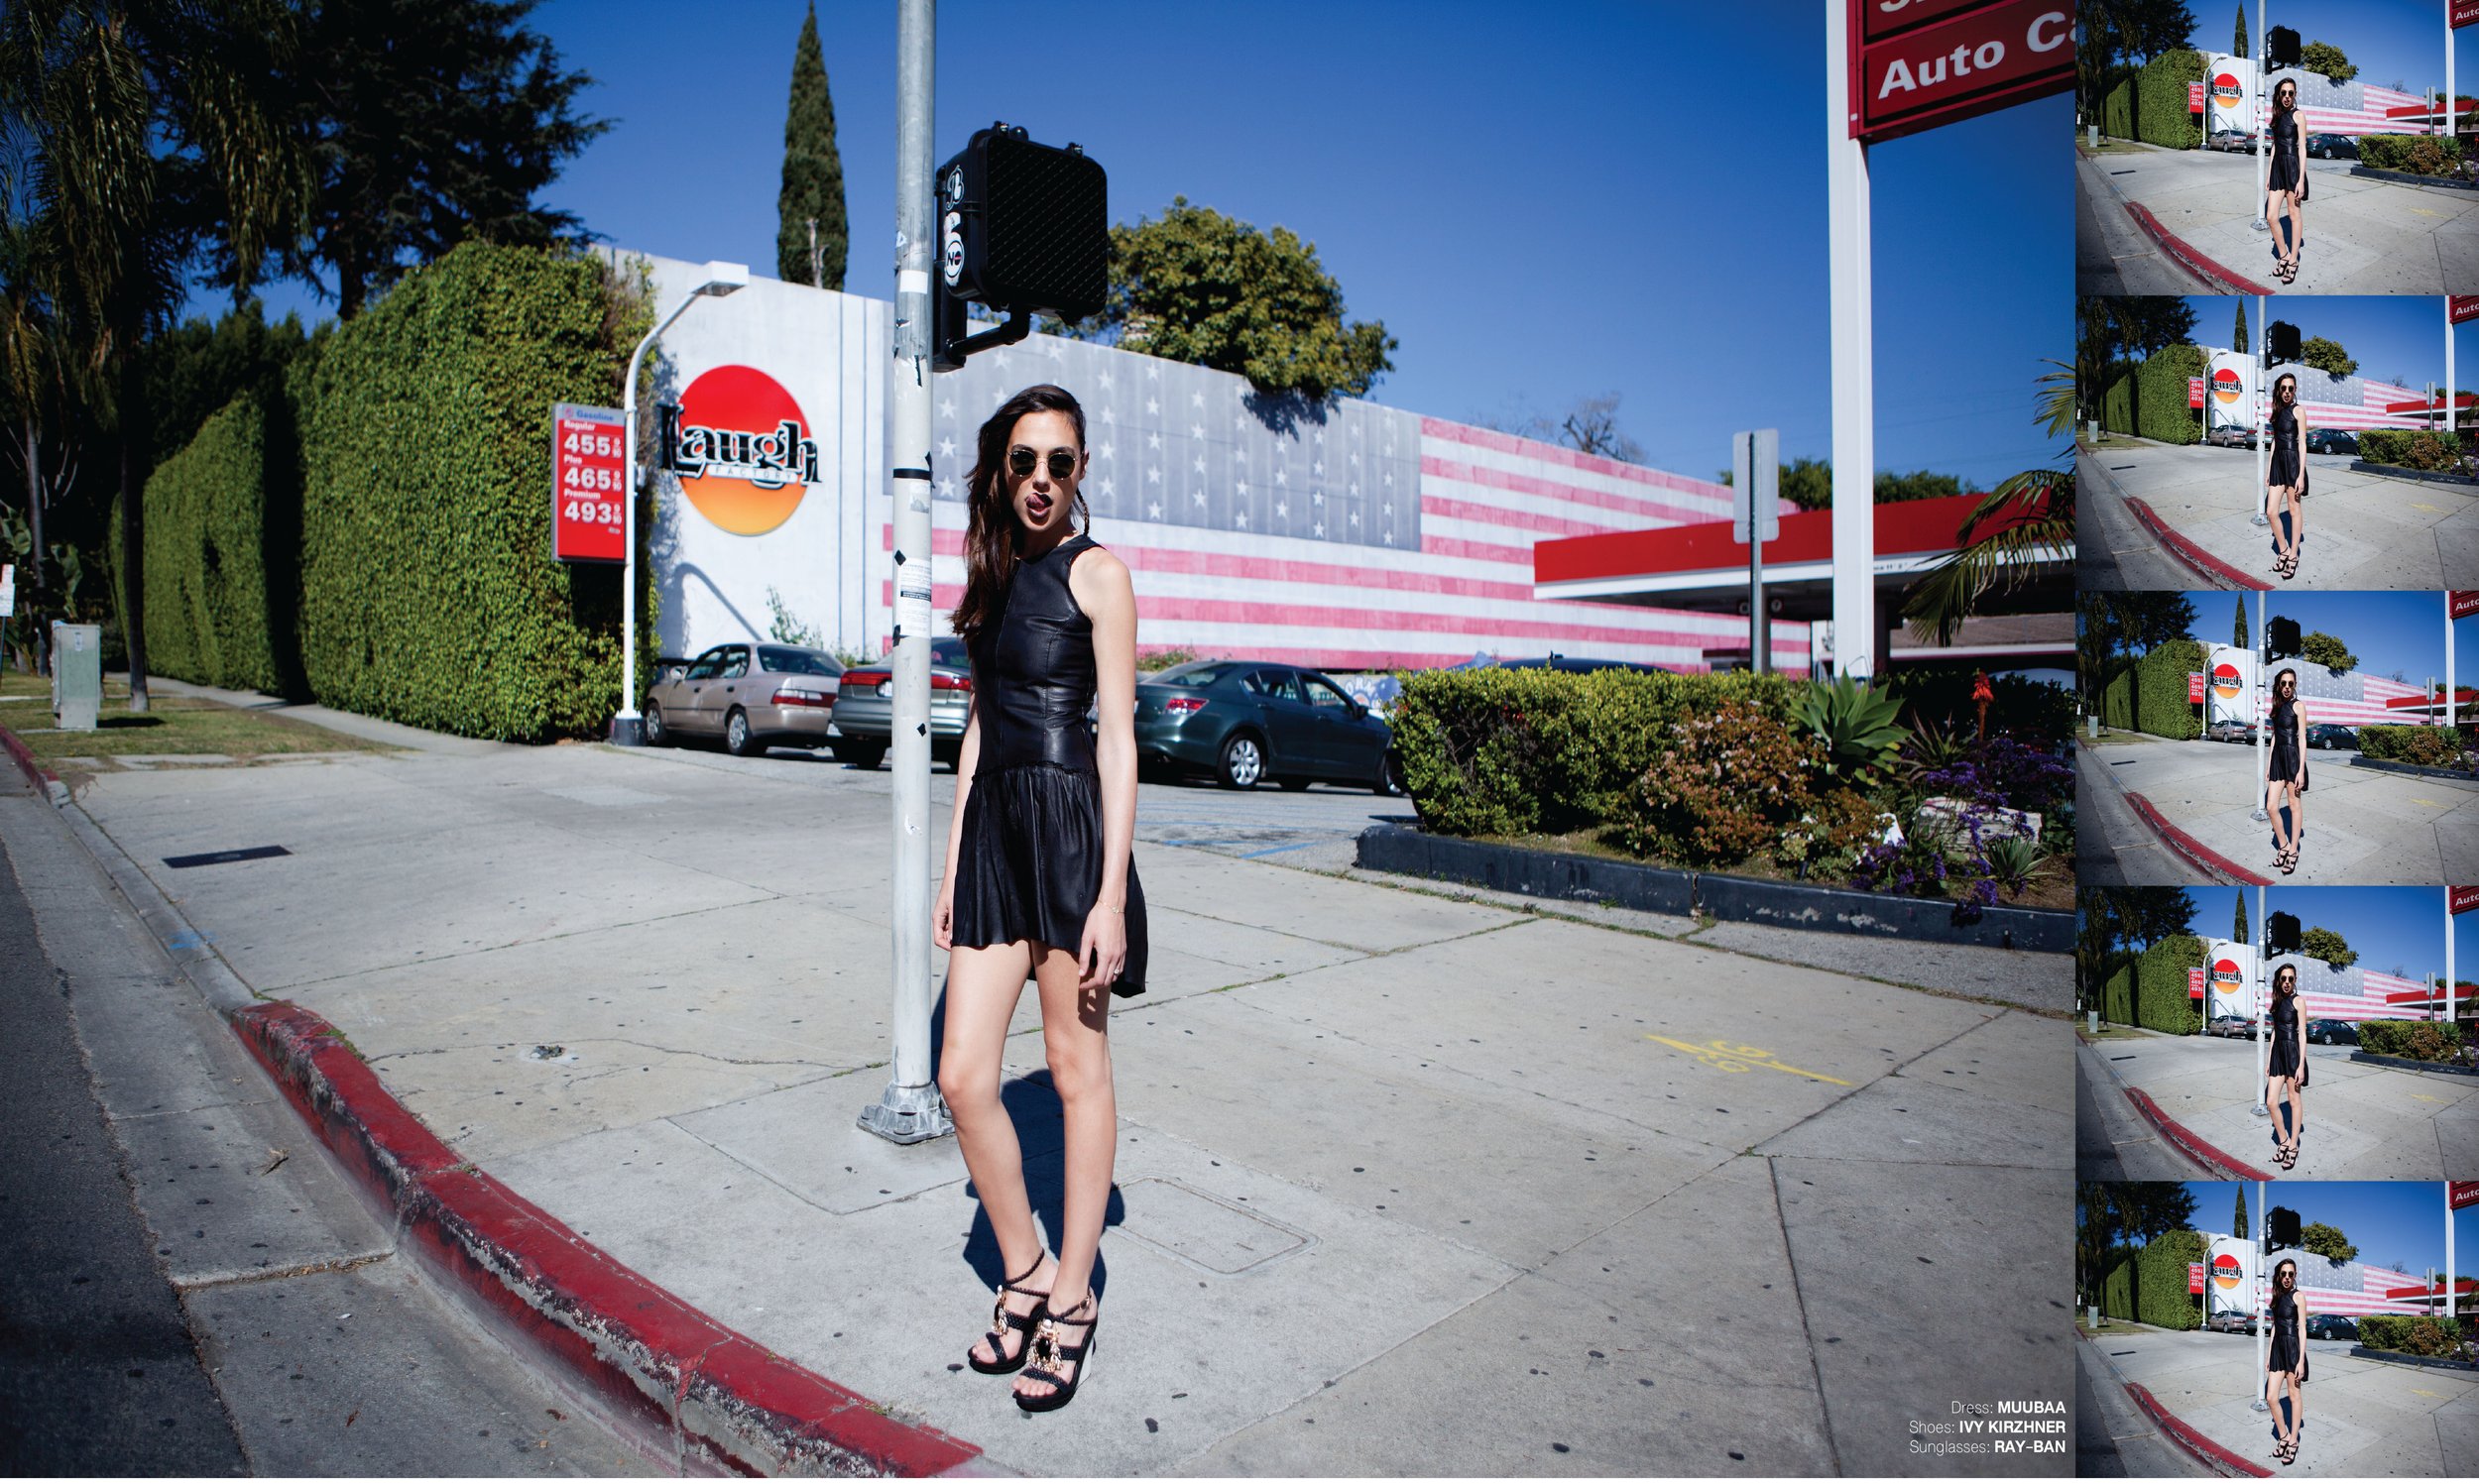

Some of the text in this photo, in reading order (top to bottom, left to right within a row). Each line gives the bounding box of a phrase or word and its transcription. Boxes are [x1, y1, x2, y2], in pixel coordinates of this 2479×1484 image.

[1878, 11, 2076, 99] Auto C
[563, 420, 596, 431] Regular
[563, 433, 611, 456] 455
[655, 403, 823, 489] Laugh
[563, 454, 582, 465] Plus
[563, 467, 611, 490] 465
[714, 466, 792, 480] FACTORY
[563, 488, 601, 500] Premium
[563, 501, 612, 523] 493
